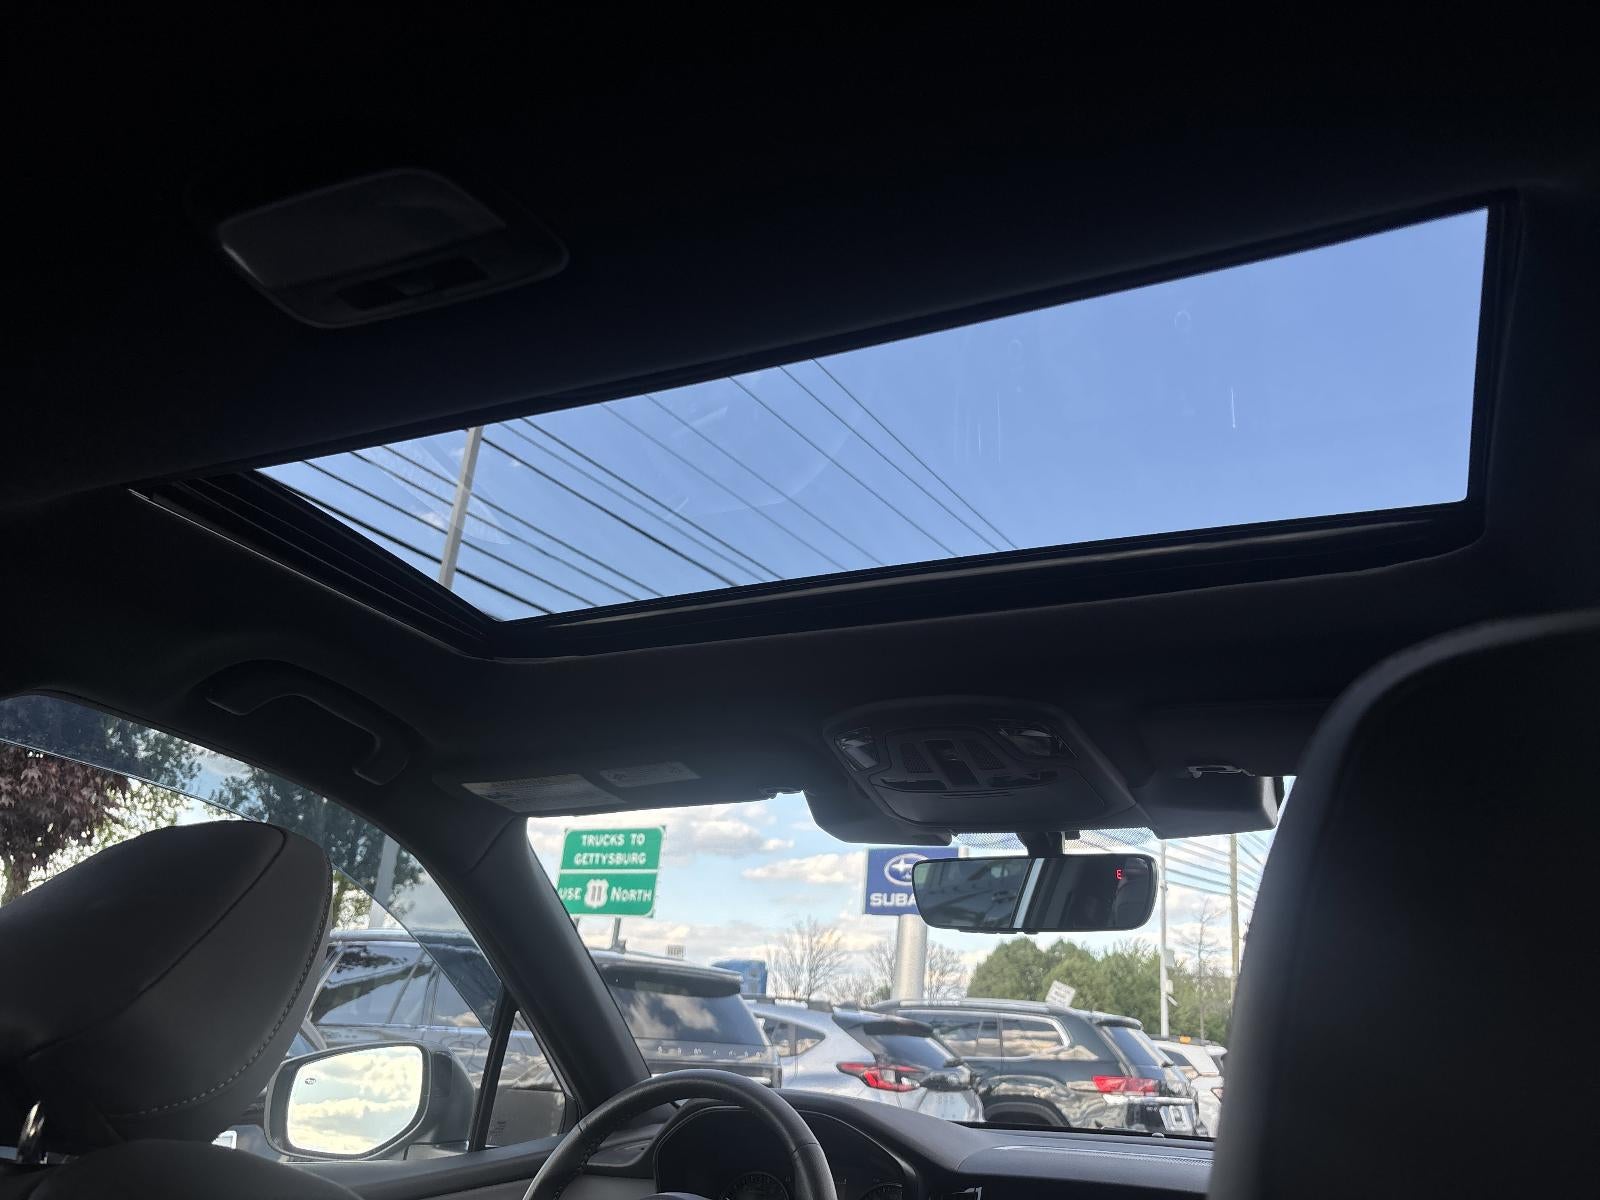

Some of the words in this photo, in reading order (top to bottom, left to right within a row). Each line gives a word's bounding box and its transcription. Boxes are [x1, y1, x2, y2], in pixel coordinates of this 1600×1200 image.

[581, 834, 625, 847] TRUCKS
[630, 833, 646, 846] TO
[573, 852, 647, 866] GETTYSBURG
[1116, 869, 1122, 880] E
[558, 887, 583, 901] USE
[610, 887, 653, 902] NORTH
